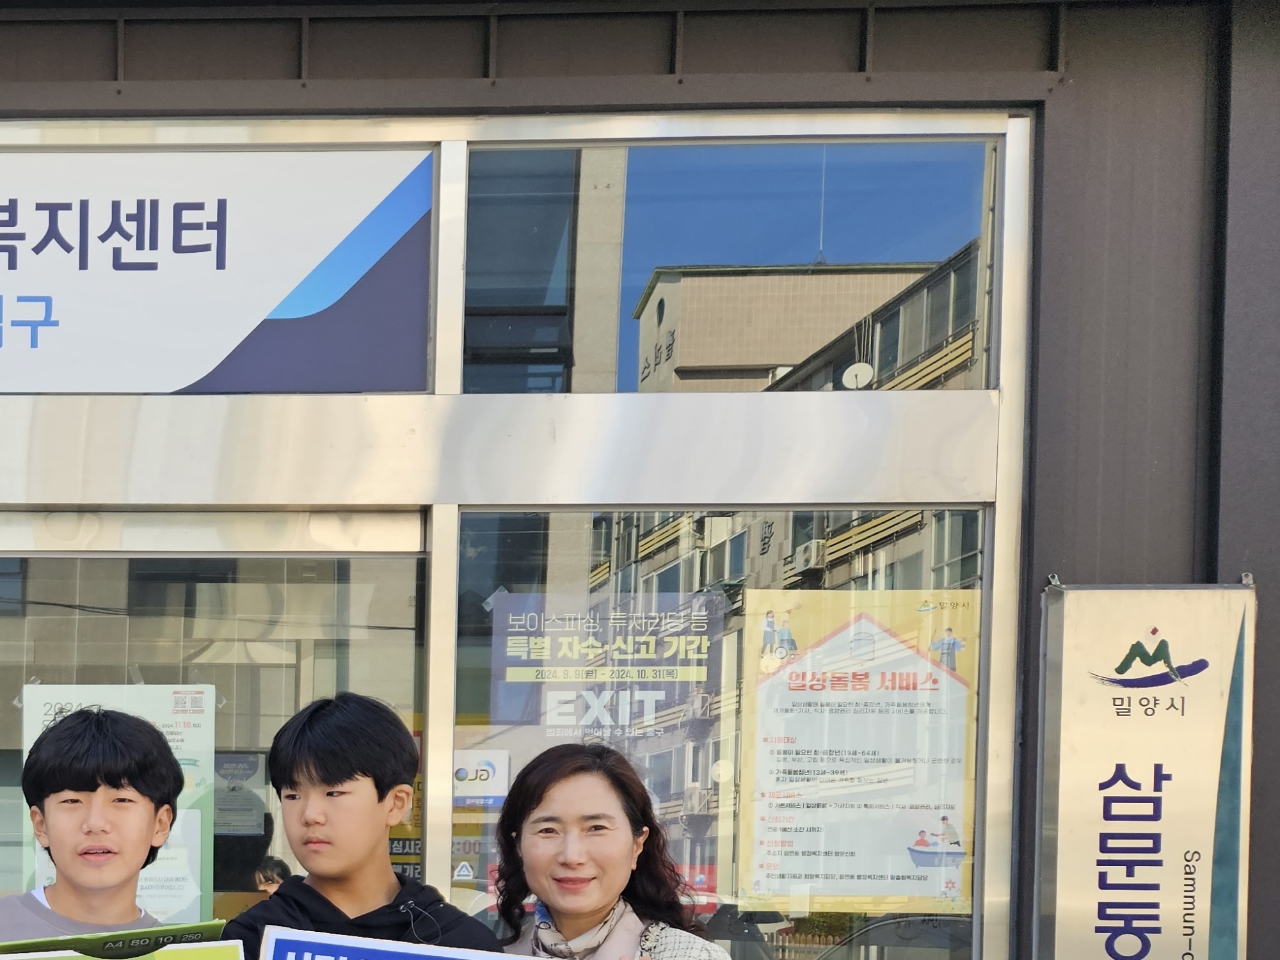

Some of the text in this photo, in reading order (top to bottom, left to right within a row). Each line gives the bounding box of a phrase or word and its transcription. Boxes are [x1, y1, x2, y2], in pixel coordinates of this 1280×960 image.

[689, 611, 709, 632] 등
[506, 636, 551, 660] 특별
[663, 635, 711, 660] 기간
[787, 671, 940, 692] 일상돌봄 서비스
[546, 690, 666, 726] EXIT
[1111, 696, 1186, 717] 밀양시
[104, 933, 202, 950] A4 80 10 250
